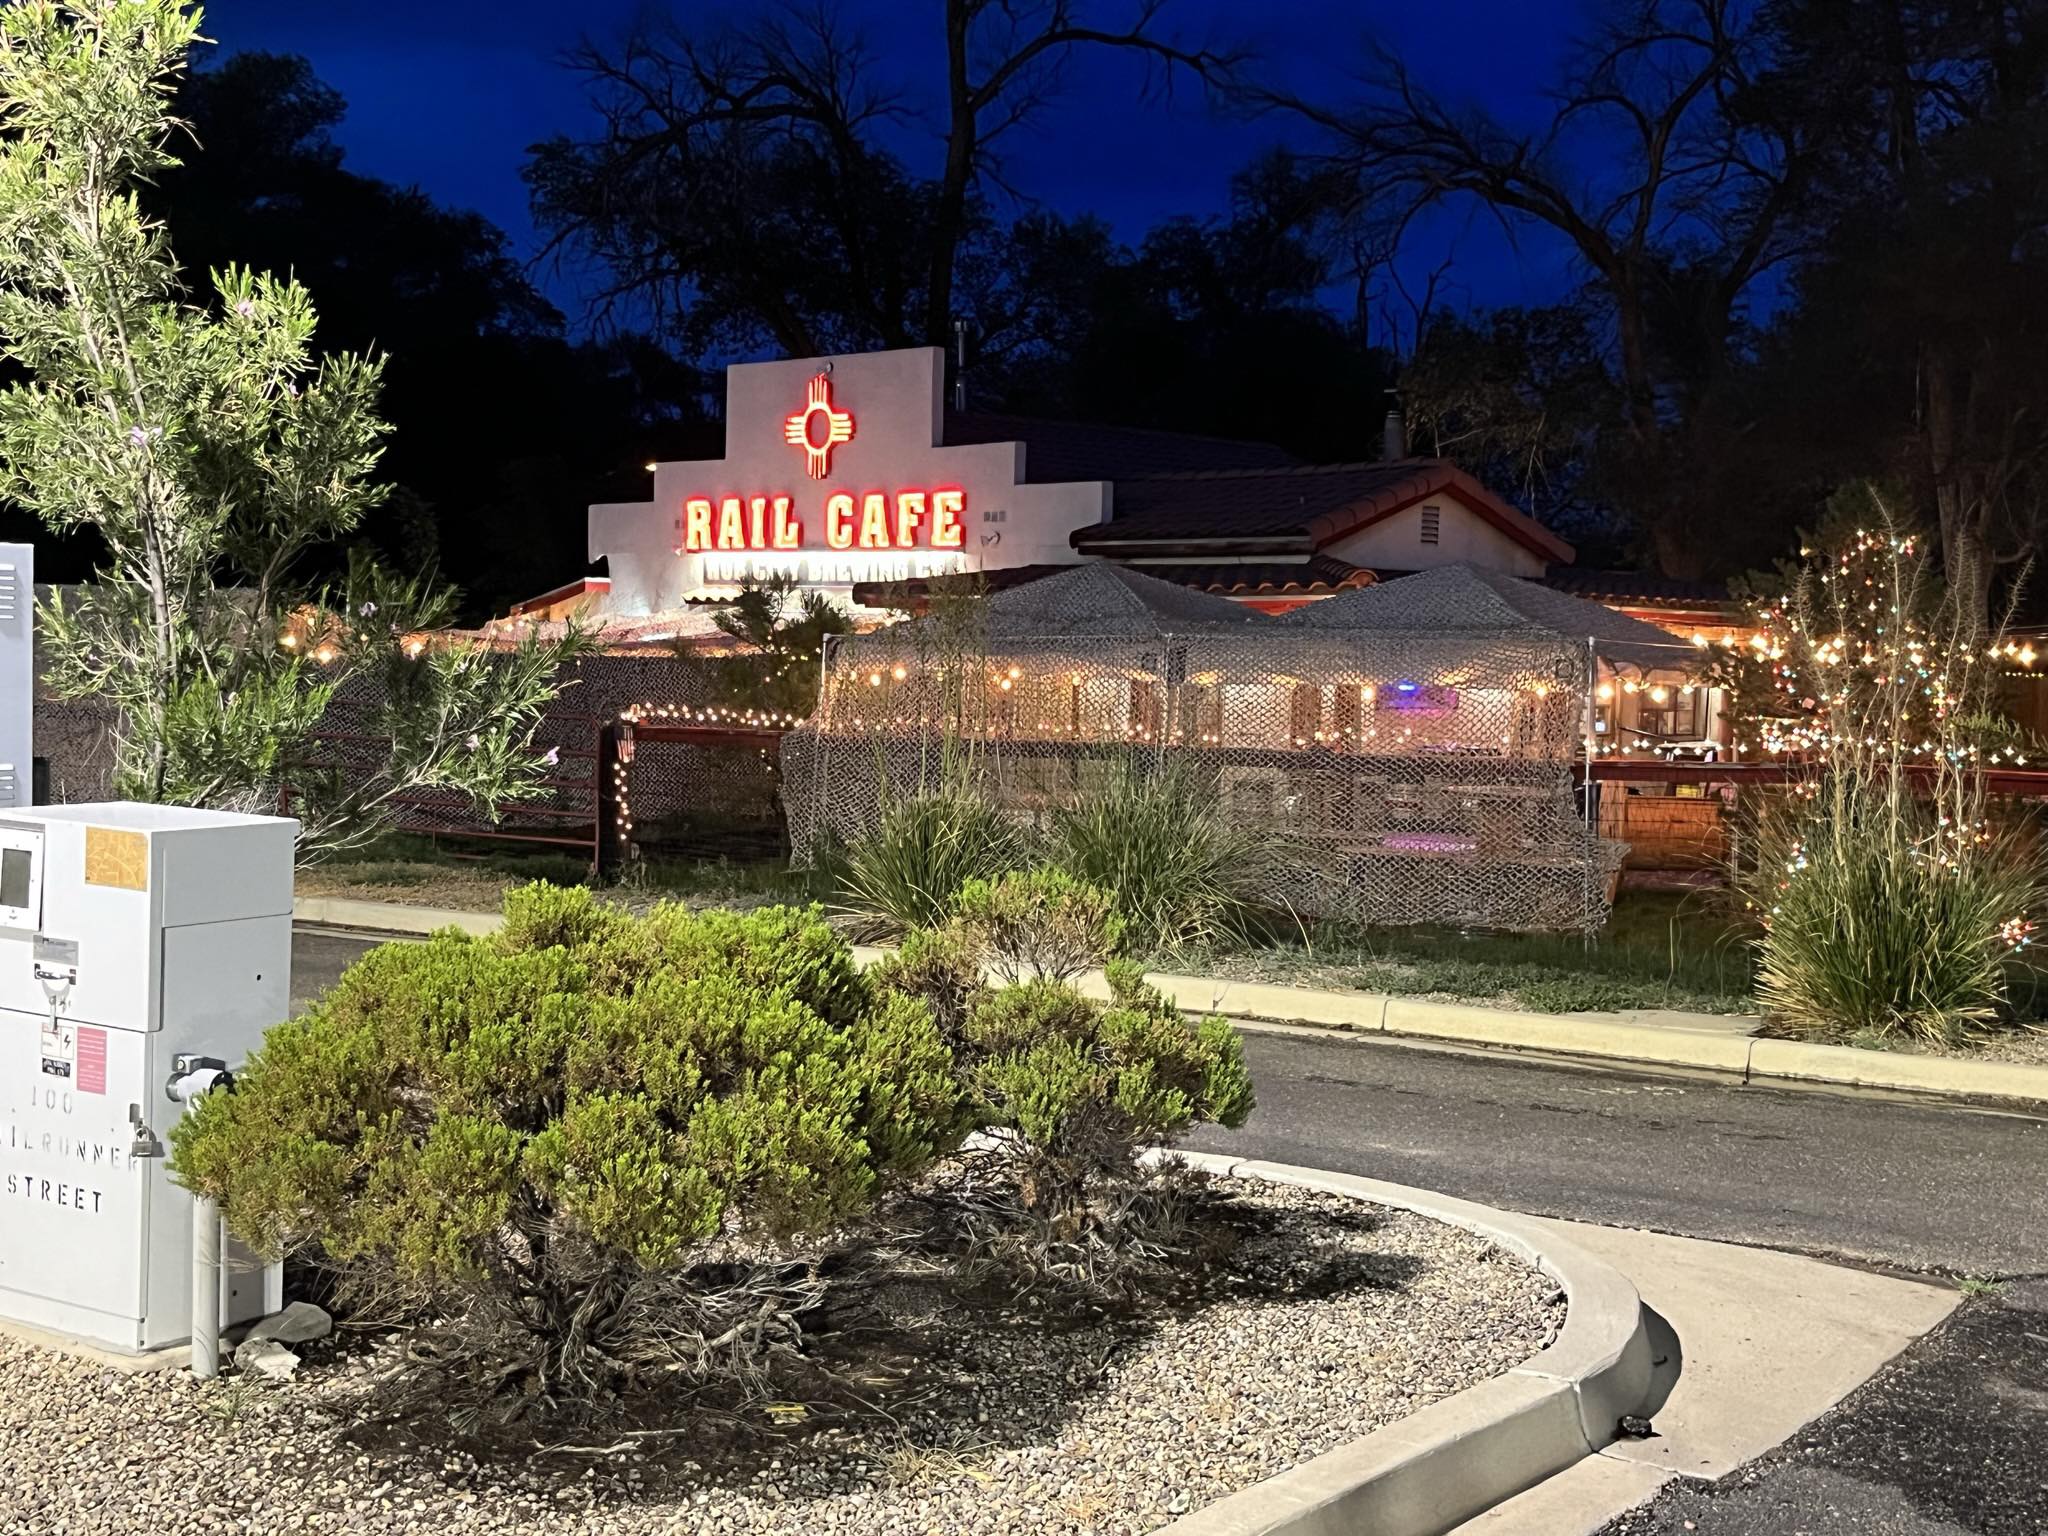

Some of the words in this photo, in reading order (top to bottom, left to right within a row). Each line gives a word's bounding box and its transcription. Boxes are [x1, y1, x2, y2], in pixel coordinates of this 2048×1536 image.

[685, 497, 801, 551] RAIL
[826, 490, 965, 550] CAFE
[31, 1085, 73, 1115] 100
[0, 1125, 138, 1172] ILRUNNER
[7, 1173, 102, 1214] STREET
